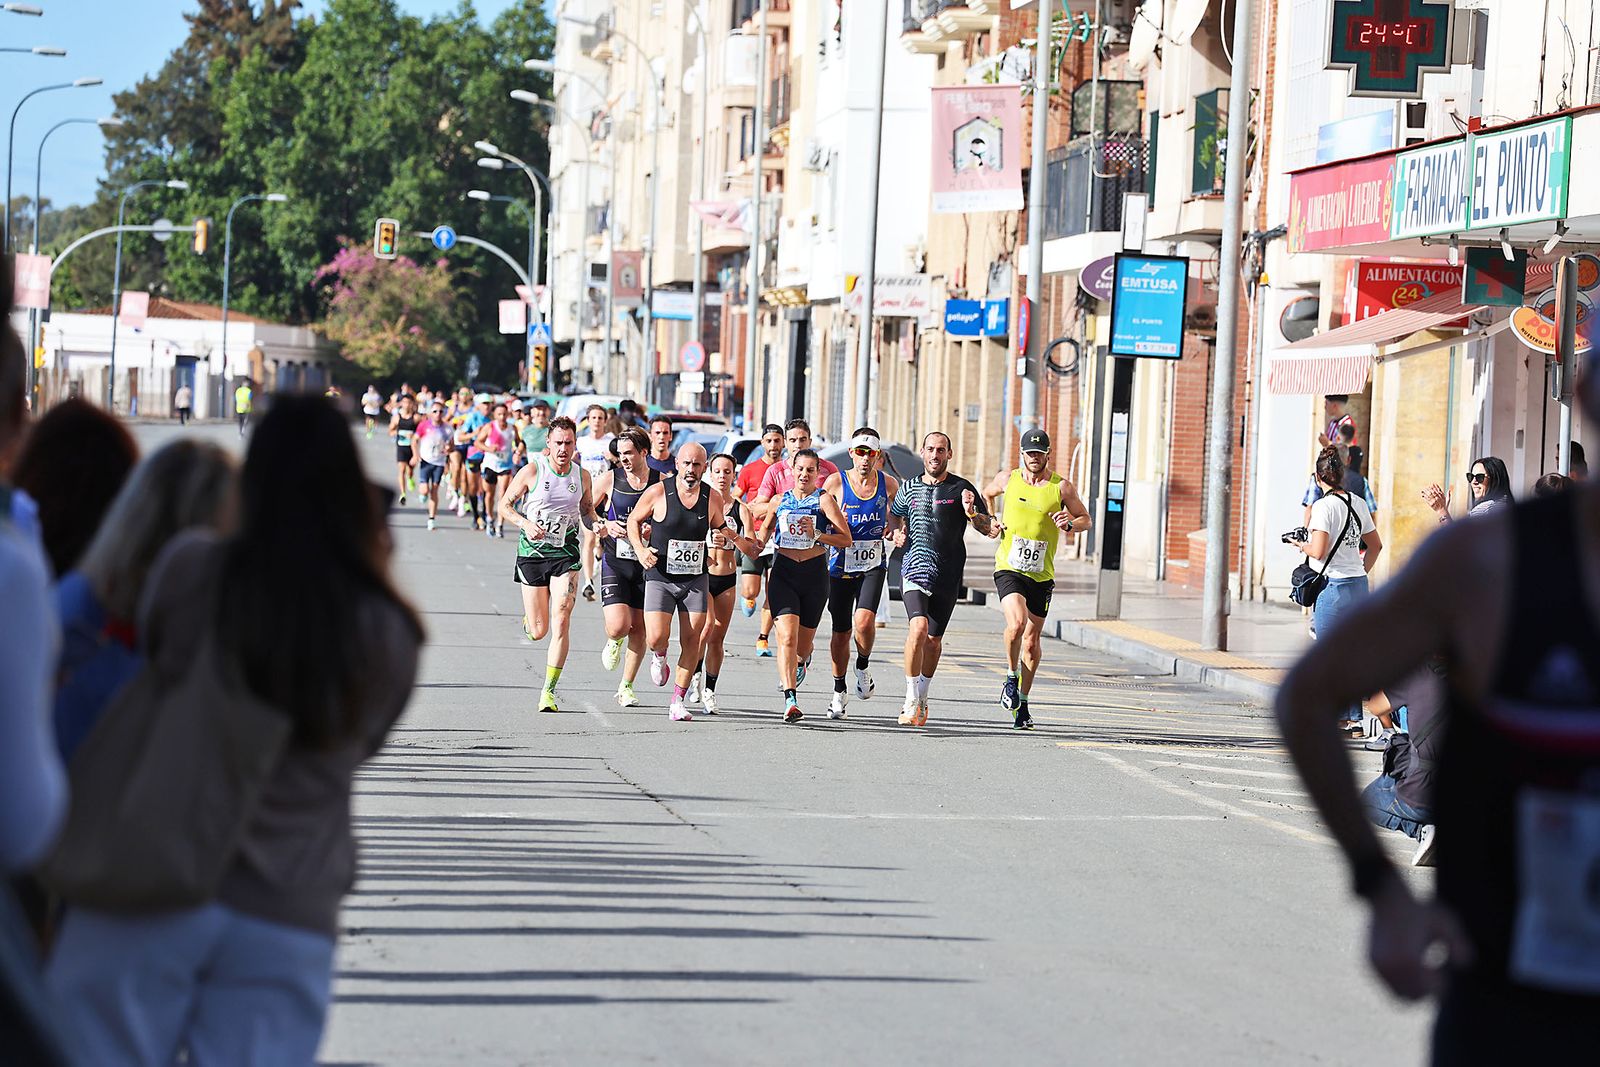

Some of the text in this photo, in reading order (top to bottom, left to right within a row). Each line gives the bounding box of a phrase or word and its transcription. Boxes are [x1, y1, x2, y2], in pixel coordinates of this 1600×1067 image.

[1405, 131, 1548, 229] FARMACIA EL PUNTO
[1121, 277, 1178, 290] EMTUSA
[1397, 287, 1418, 300] 24
[851, 512, 881, 523] FIAAL
[674, 549, 700, 562] 266
[853, 548, 876, 561] 106
[1018, 547, 1040, 561] 196
